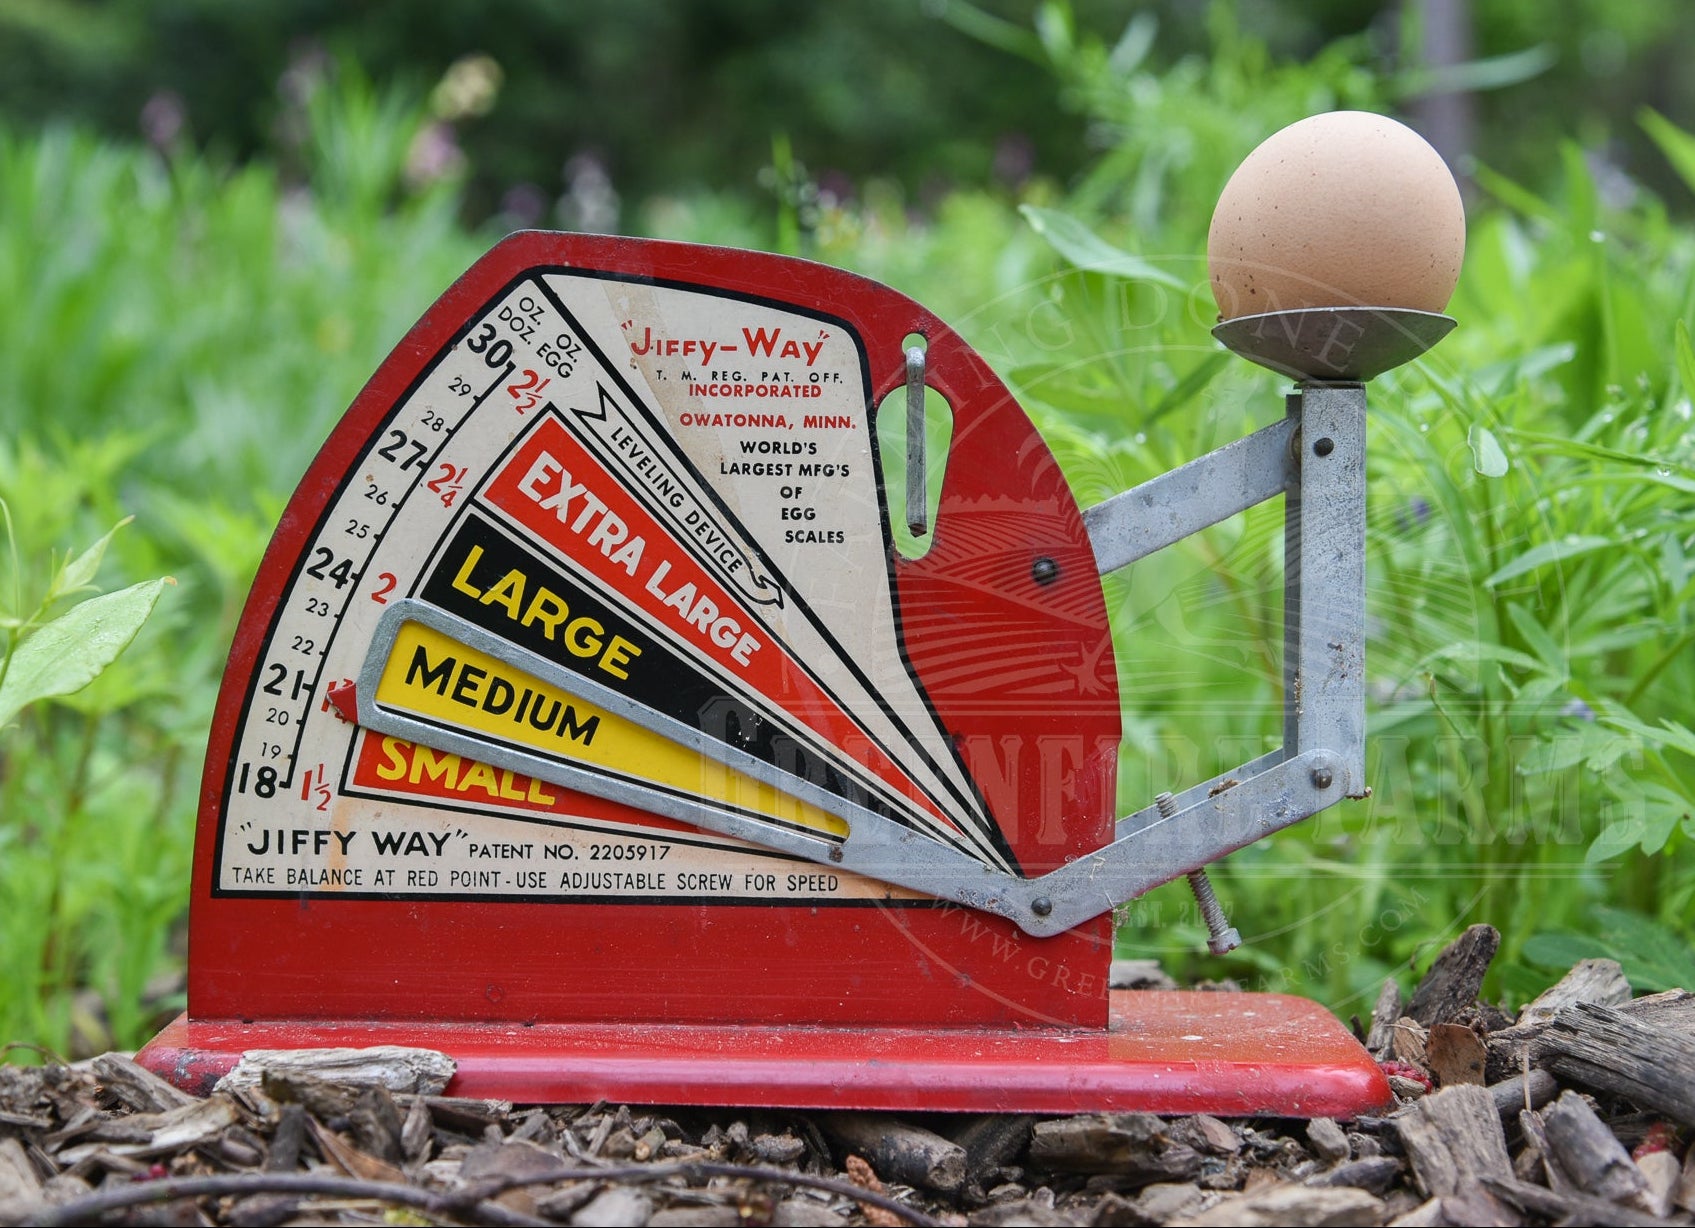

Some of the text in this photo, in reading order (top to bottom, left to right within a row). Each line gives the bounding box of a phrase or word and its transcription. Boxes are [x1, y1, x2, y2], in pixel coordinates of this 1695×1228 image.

[519, 297, 545, 325] OZ.
[498, 306, 535, 345] DOZ.
[467, 324, 513, 368] 30
[556, 334, 582, 363] OZ.
[536, 343, 573, 378] EGG
[448, 377, 472, 397] 29
[656, 370, 843, 384] T. M. REG. PAT. OFF.
[689, 384, 822, 398] INCORPORATED
[421, 410, 444, 431] 28
[680, 413, 856, 430] OWATONNA, MINN.
[378, 430, 428, 471] 27
[740, 441, 817, 454] WORLD'S
[720, 463, 850, 477] LARGEST MFG'S
[364, 484, 387, 505] 26
[610, 427, 743, 574] LEVELING DEVICE
[780, 486, 803, 499] OF
[781, 507, 816, 521] EGG
[345, 520, 370, 539] 25
[785, 530, 845, 543] SCALES
[306, 547, 353, 589] 24
[517, 450, 761, 667] EXTRA LARGE
[371, 572, 397, 604] 2
[305, 598, 329, 617] 23
[452, 545, 642, 680] LARGE
[291, 636, 315, 655] 22
[263, 663, 304, 700] 21
[405, 645, 601, 746] MEDIUM
[266, 708, 289, 725] 20
[261, 742, 281, 759] 19
[238, 763, 278, 799] 18
[376, 737, 555, 806] SMALL
[239, 822, 671, 860] "JIFFY WAY" PATENT NO. 2205917
[232, 867, 275, 884] TAKE
[287, 868, 362, 886] BALANCE
[374, 869, 396, 886] AT
[407, 870, 438, 887] RED
[560, 872, 666, 890] ADJUSTABLE
[677, 873, 732, 891] SCREW
[745, 874, 776, 891] FOR
[787, 875, 838, 892] SPEED
